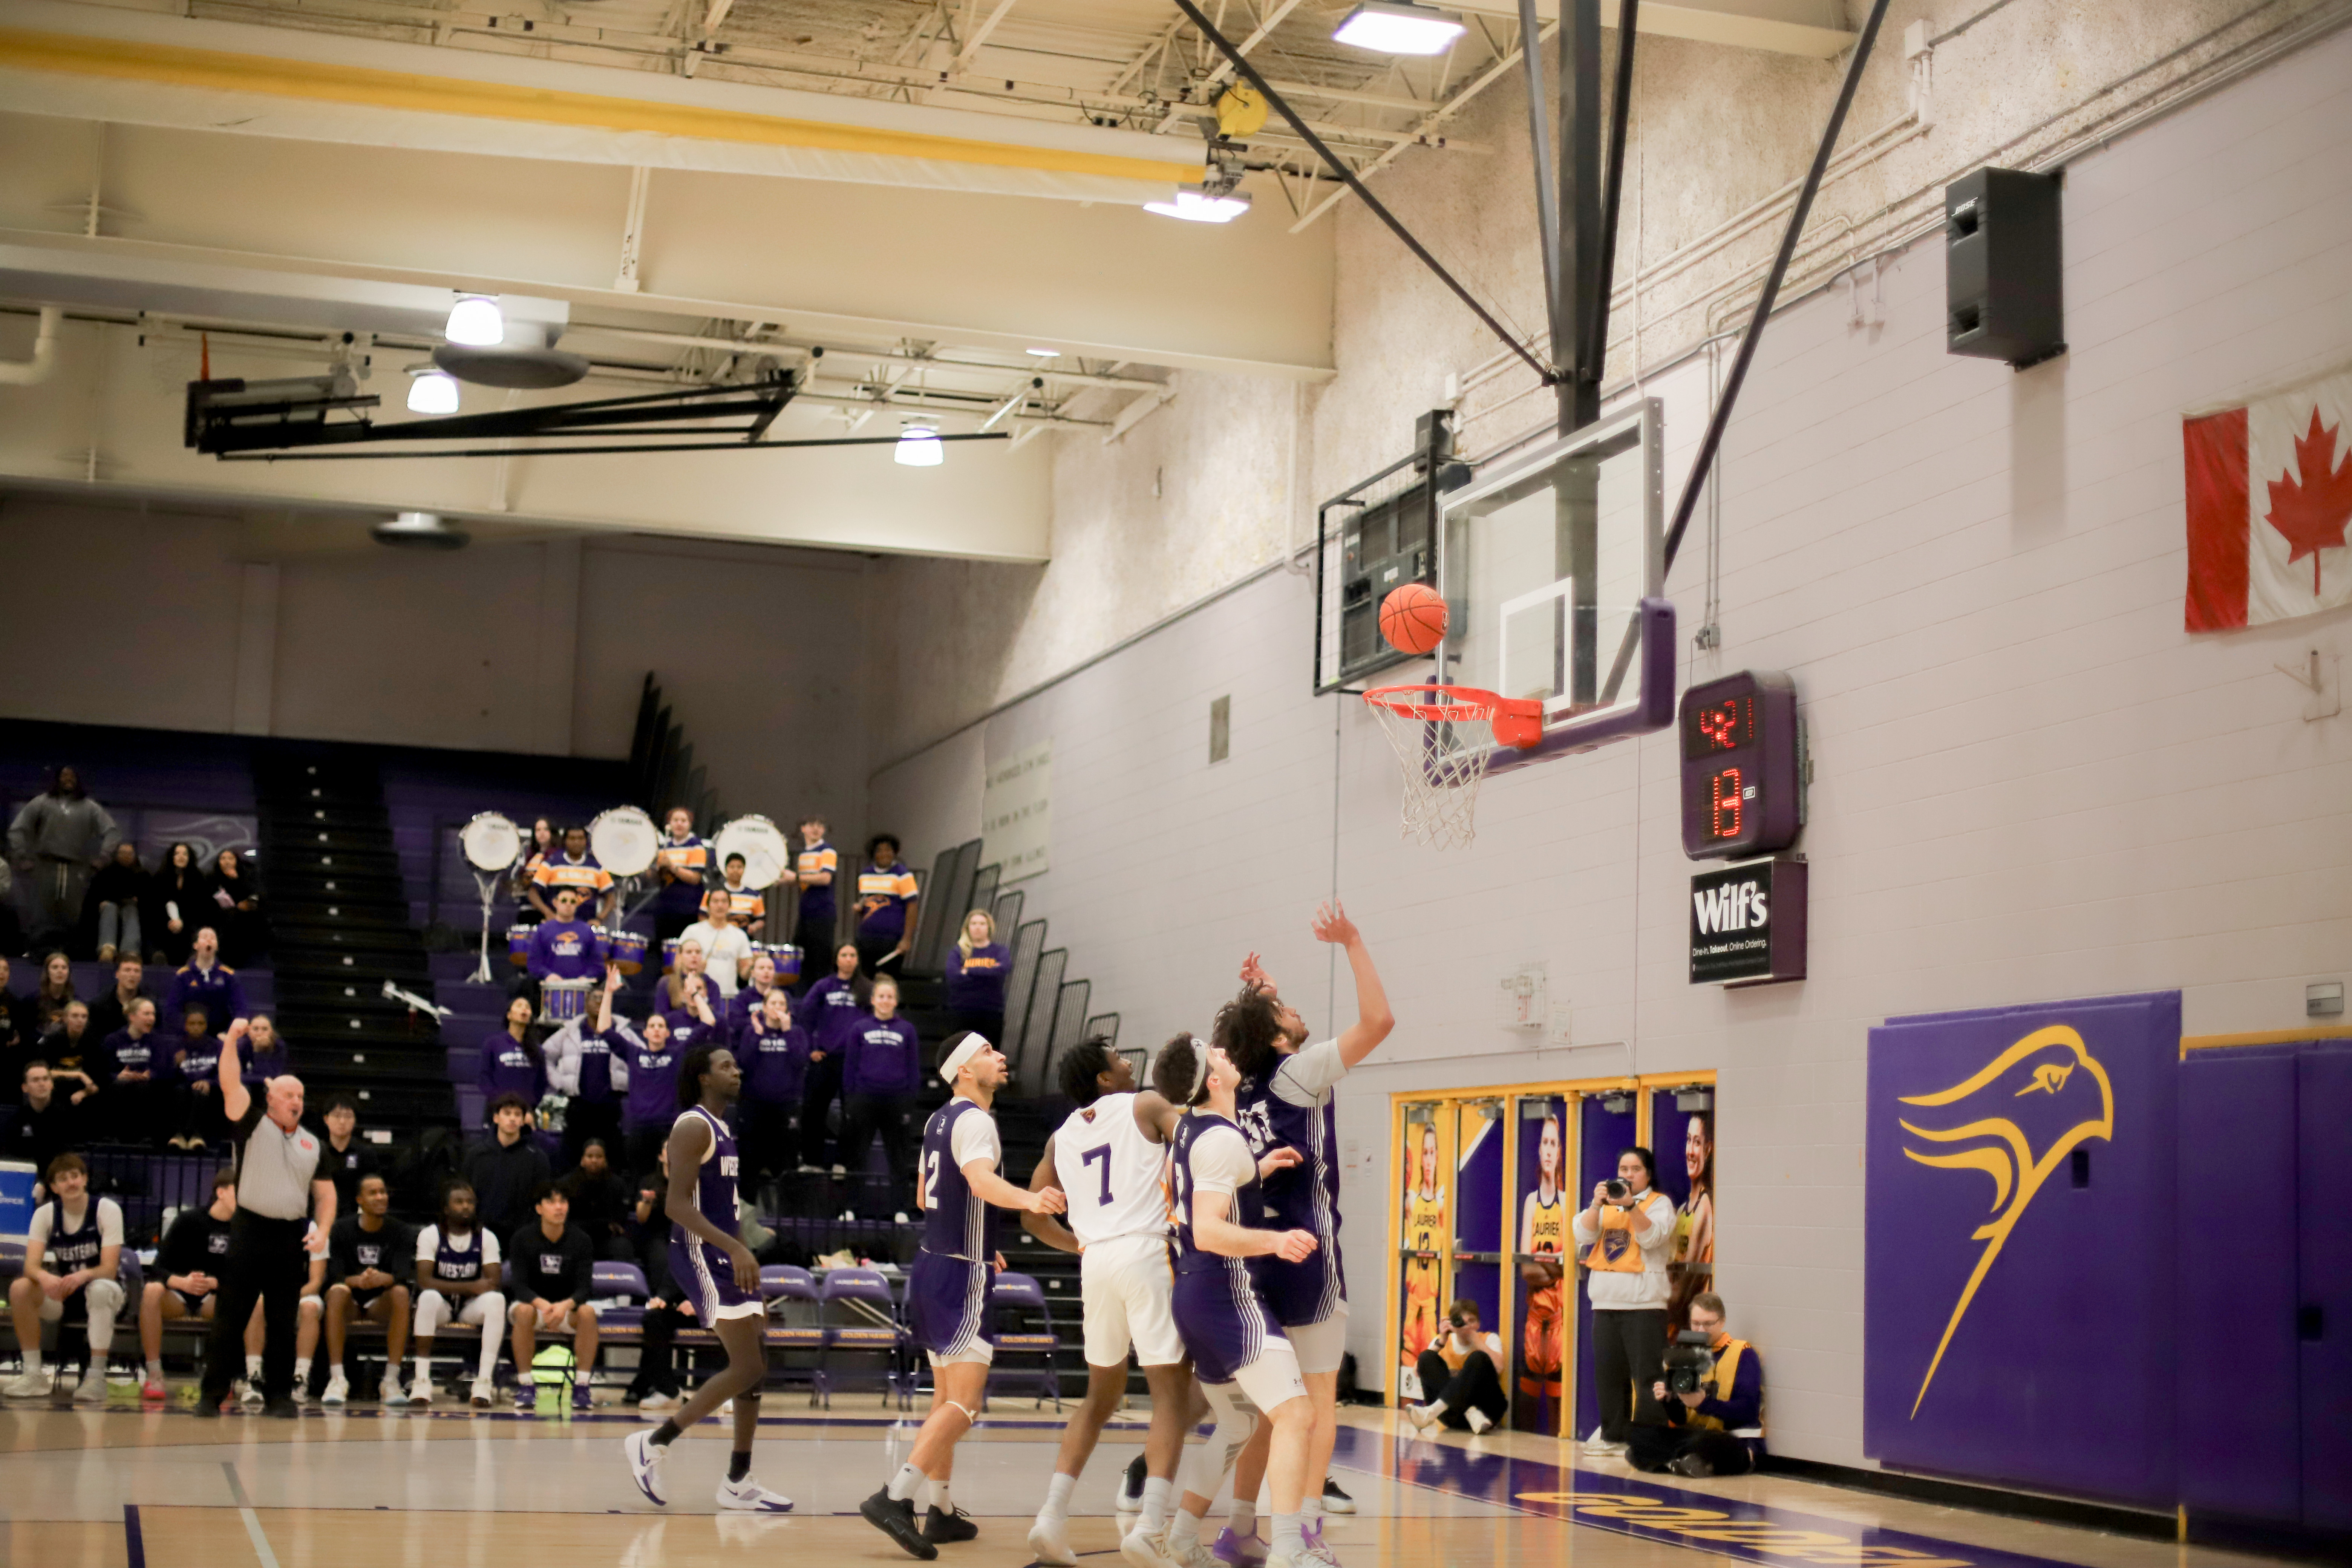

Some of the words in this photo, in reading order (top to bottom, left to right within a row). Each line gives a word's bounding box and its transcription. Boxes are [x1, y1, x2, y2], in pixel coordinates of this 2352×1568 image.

[1951, 197, 1978, 217] BOSE
[1714, 768, 1740, 837] 13
[1694, 881, 1767, 934] Wilf's
[1693, 947, 1709, 957] Dine-In.
[1710, 943, 1729, 954] Takeout.
[1729, 942, 1744, 951] Online
[1745, 938, 1767, 948] Ordering.
[925, 1150, 940, 1209] 2
[1081, 1142, 1114, 1207] 7
